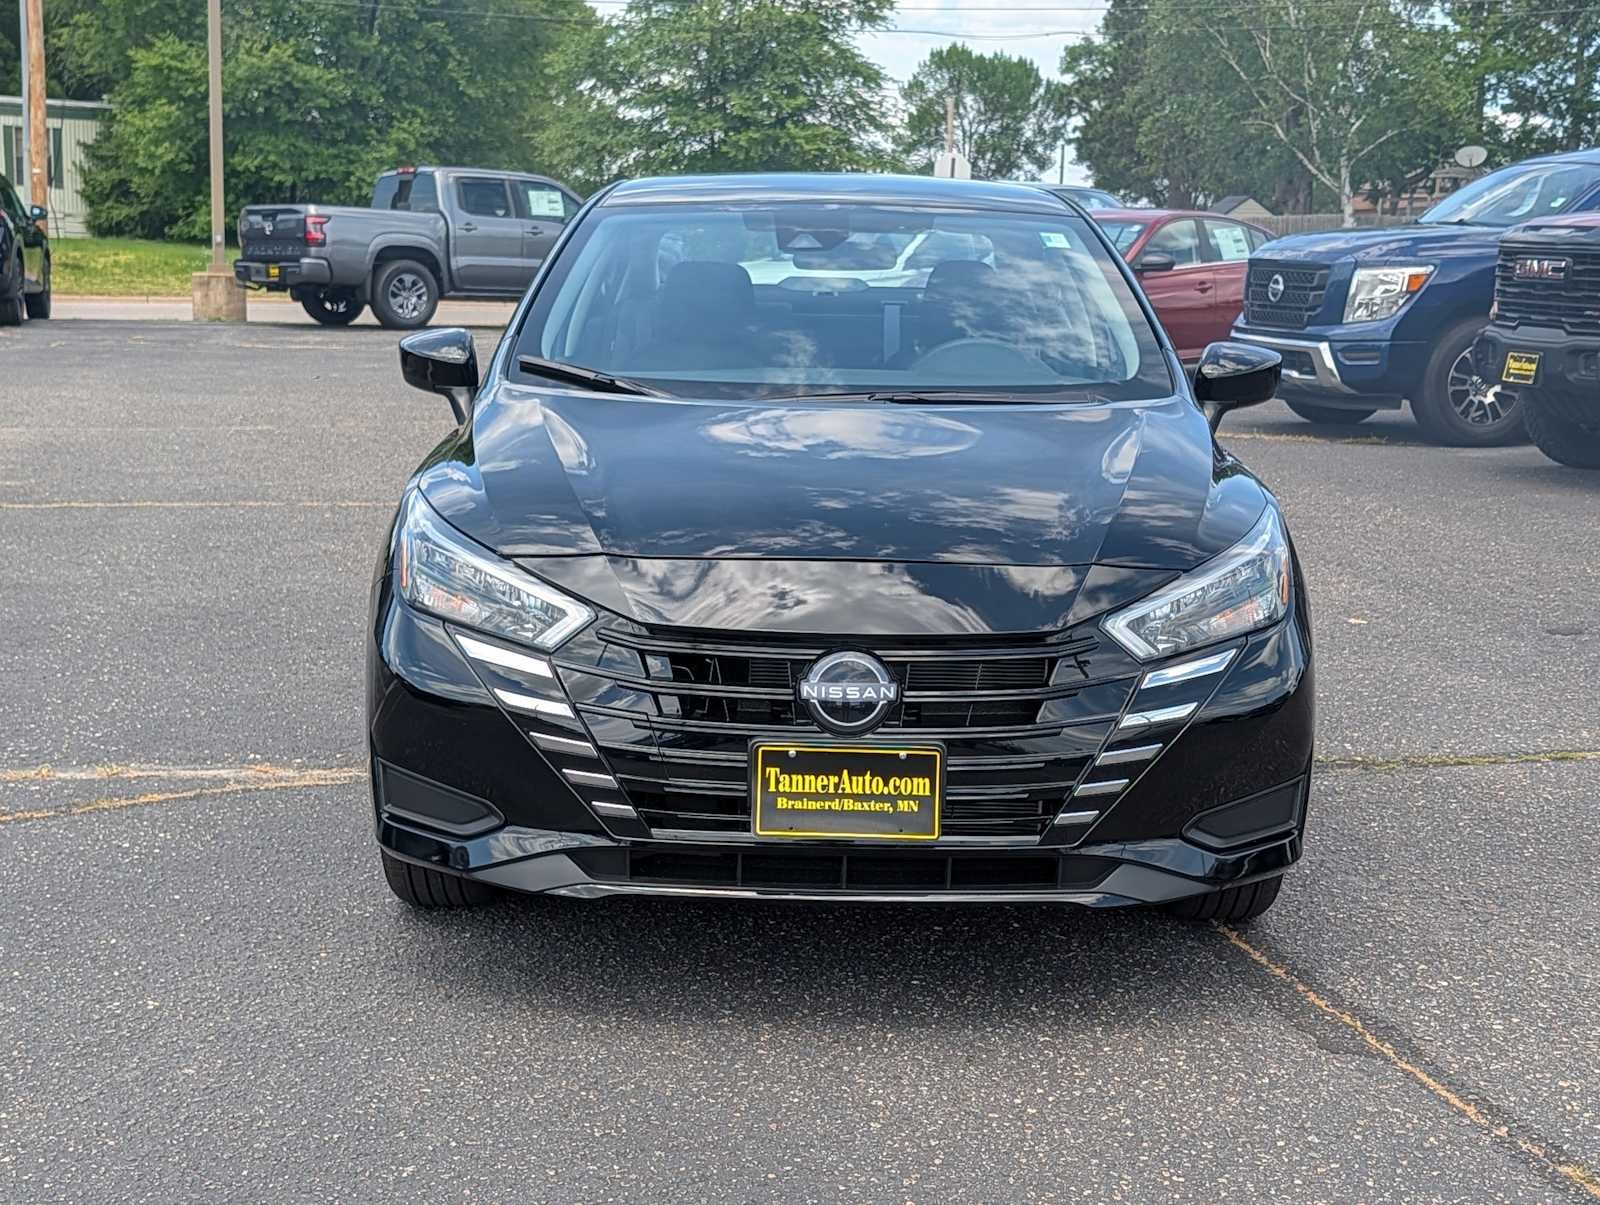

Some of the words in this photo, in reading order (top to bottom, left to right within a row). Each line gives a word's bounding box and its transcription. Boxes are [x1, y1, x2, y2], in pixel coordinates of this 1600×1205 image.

[1515, 260, 1566, 278] GMC
[803, 685, 895, 699] NISSAN
[766, 767, 931, 796] TannerAuto.com
[776, 797, 894, 813] Brainerd/Baxter,
[896, 800, 919, 812] MN
